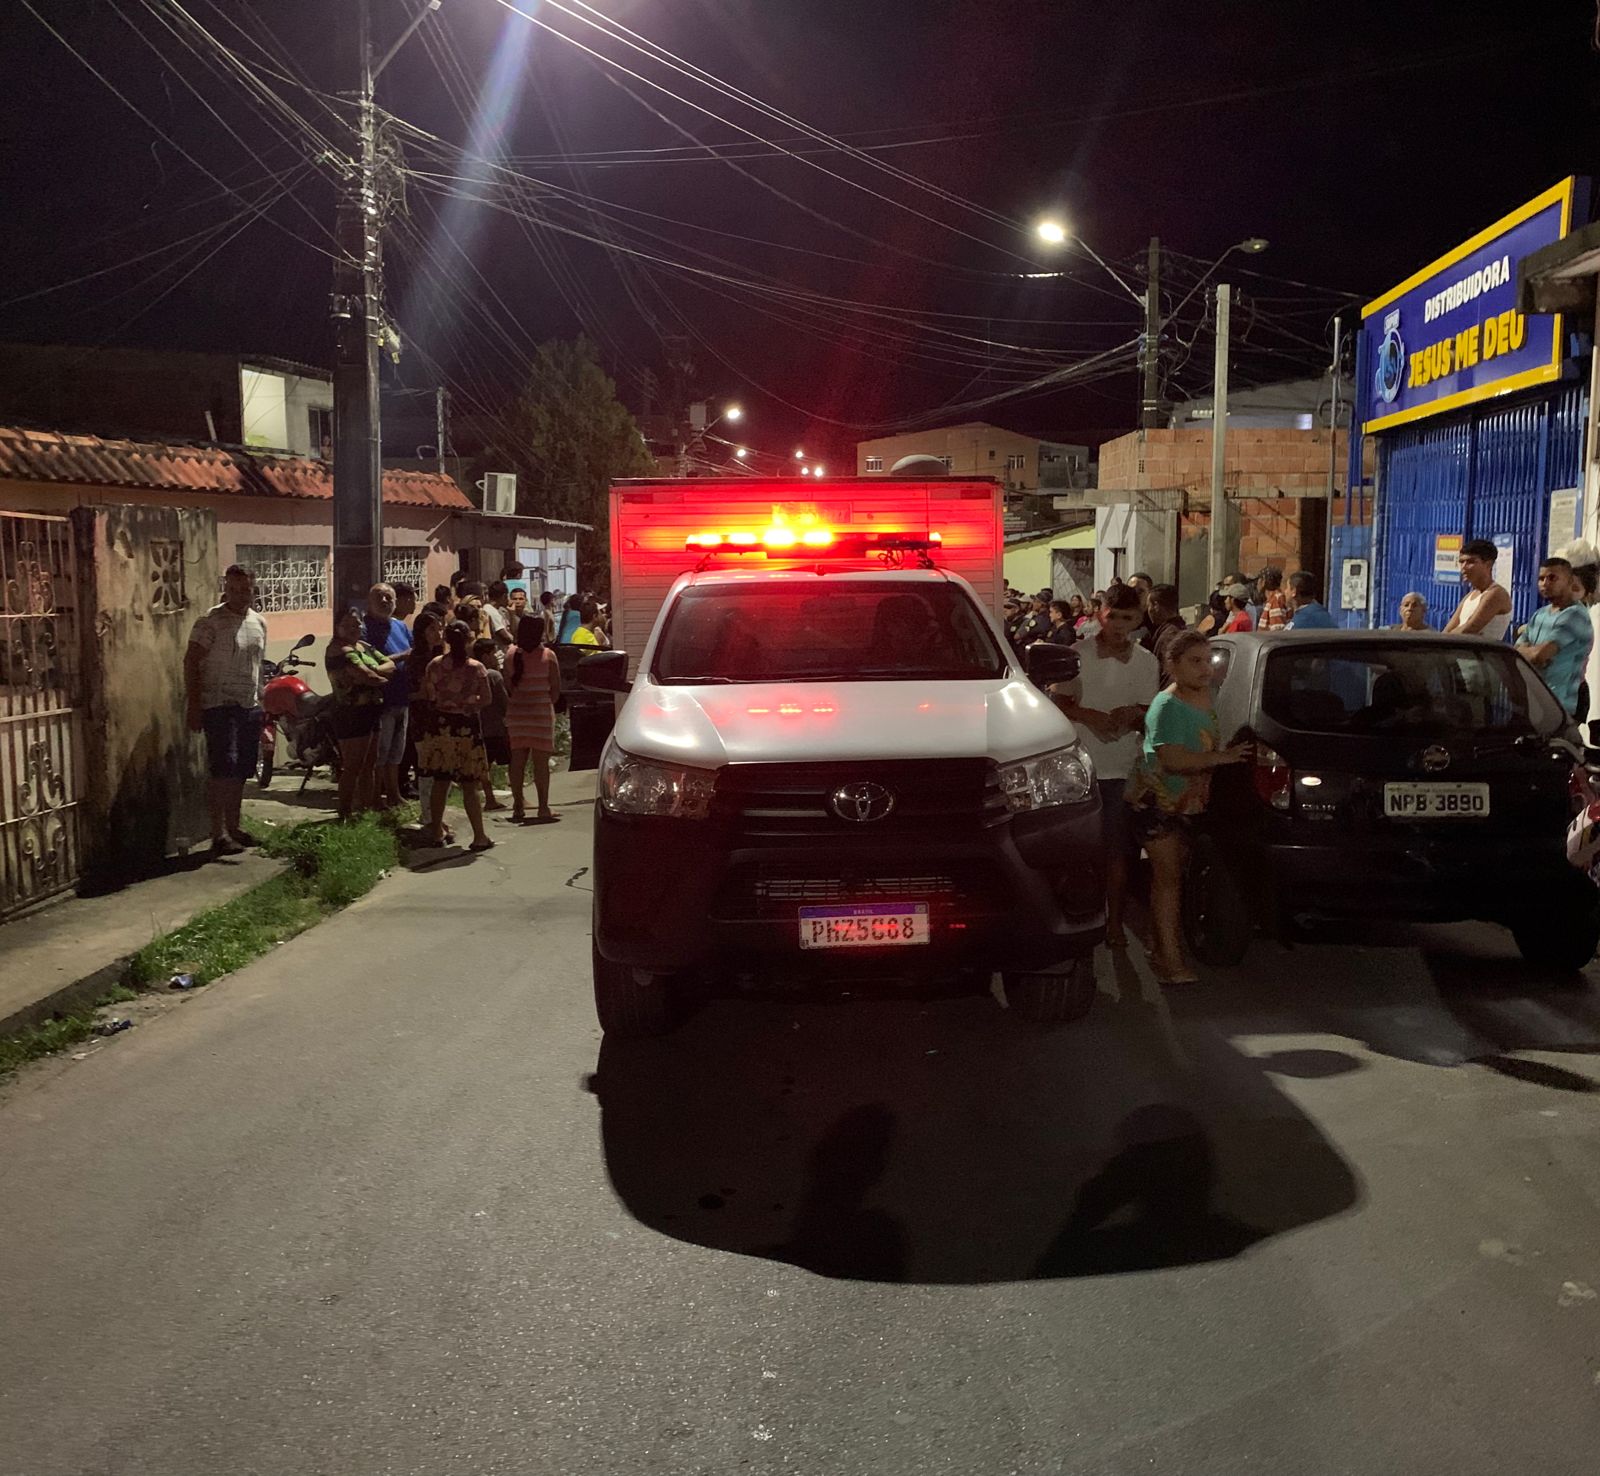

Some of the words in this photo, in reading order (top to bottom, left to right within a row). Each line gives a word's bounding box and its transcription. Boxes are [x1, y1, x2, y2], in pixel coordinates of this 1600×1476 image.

[1424, 255, 1510, 324] DISTRIBUIDORA
[1408, 337, 1451, 388] JESUS
[1454, 324, 1480, 371] ME
[1483, 308, 1525, 361] DEU
[1390, 794, 1427, 811] NPB
[1435, 794, 1484, 811] 3890
